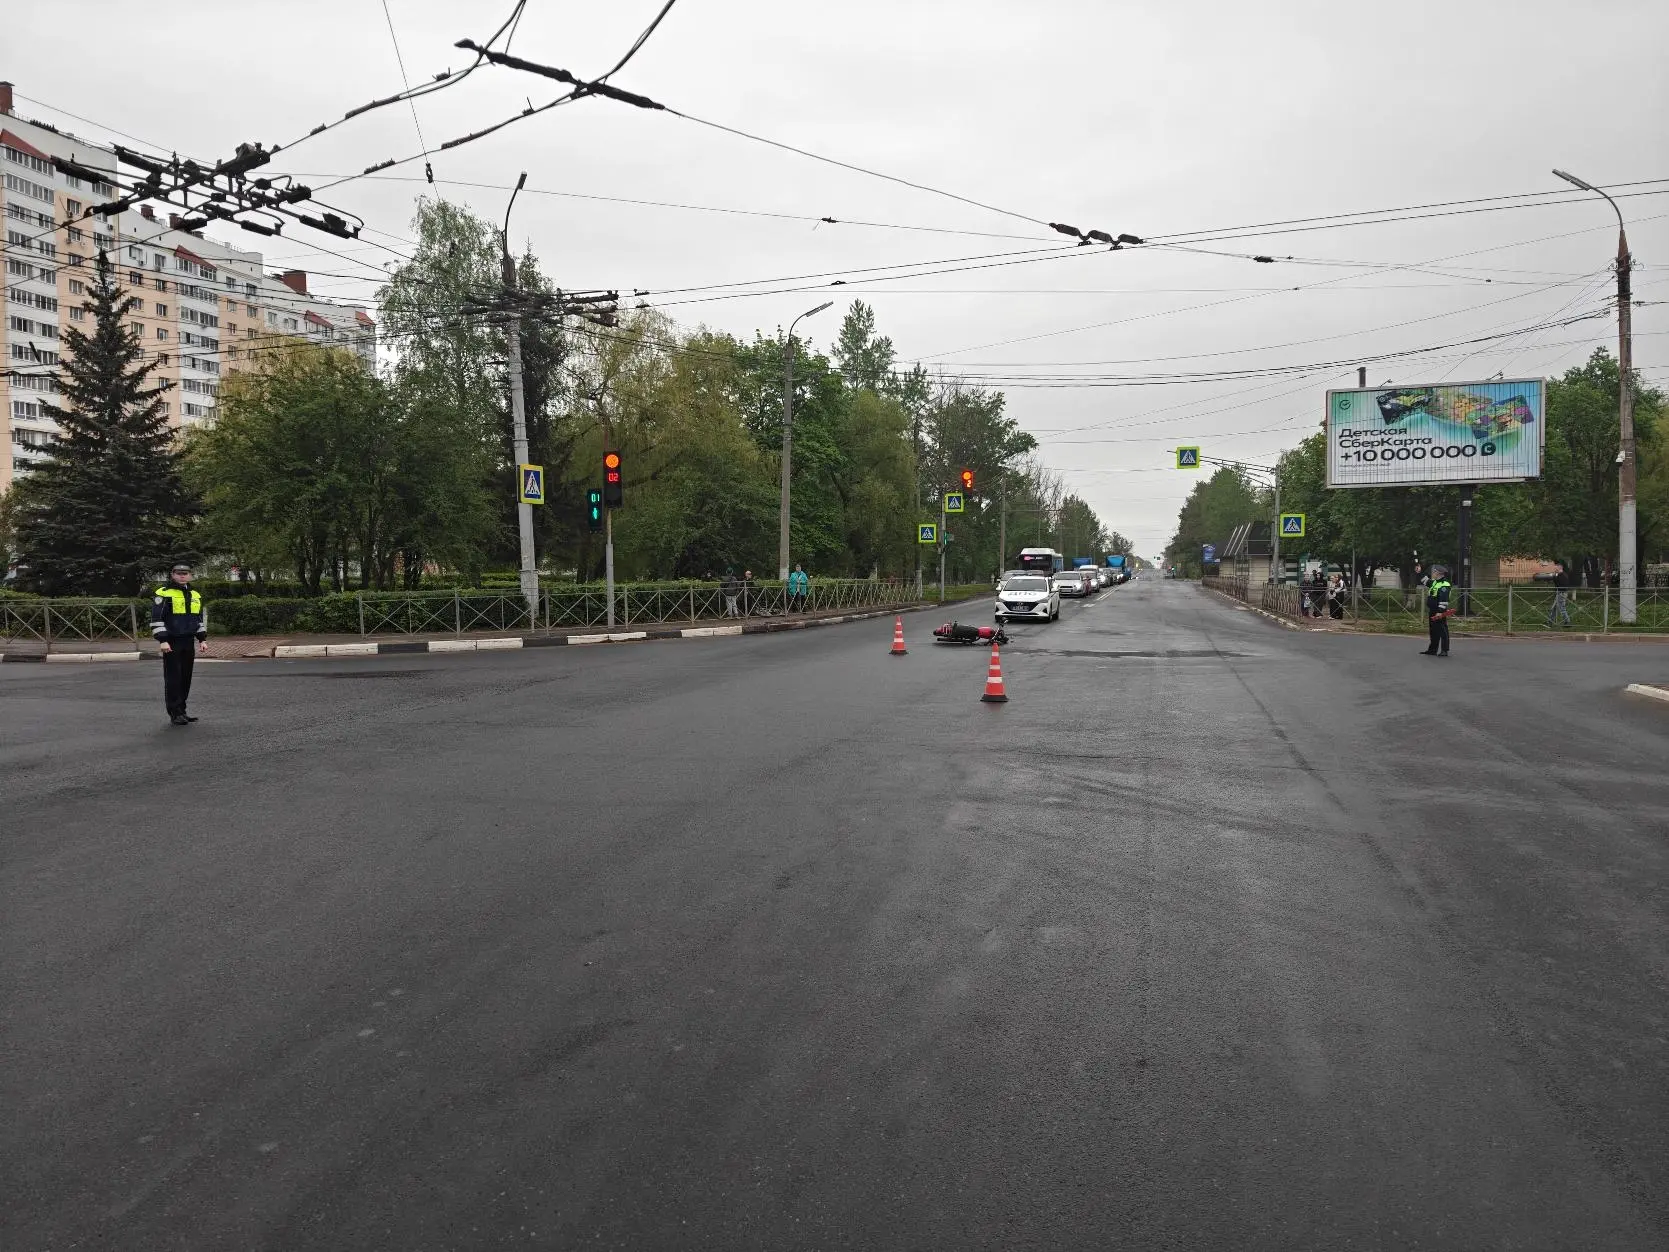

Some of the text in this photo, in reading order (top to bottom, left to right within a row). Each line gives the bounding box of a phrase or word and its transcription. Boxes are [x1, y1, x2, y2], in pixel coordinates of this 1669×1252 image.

[1339, 428, 1407, 439] Детская
[1340, 437, 1432, 448] СберКарта
[1340, 449, 1377, 462] +10
[1381, 447, 1426, 461] 000
[1430, 445, 1477, 459] 000
[608, 472, 618, 482] 02
